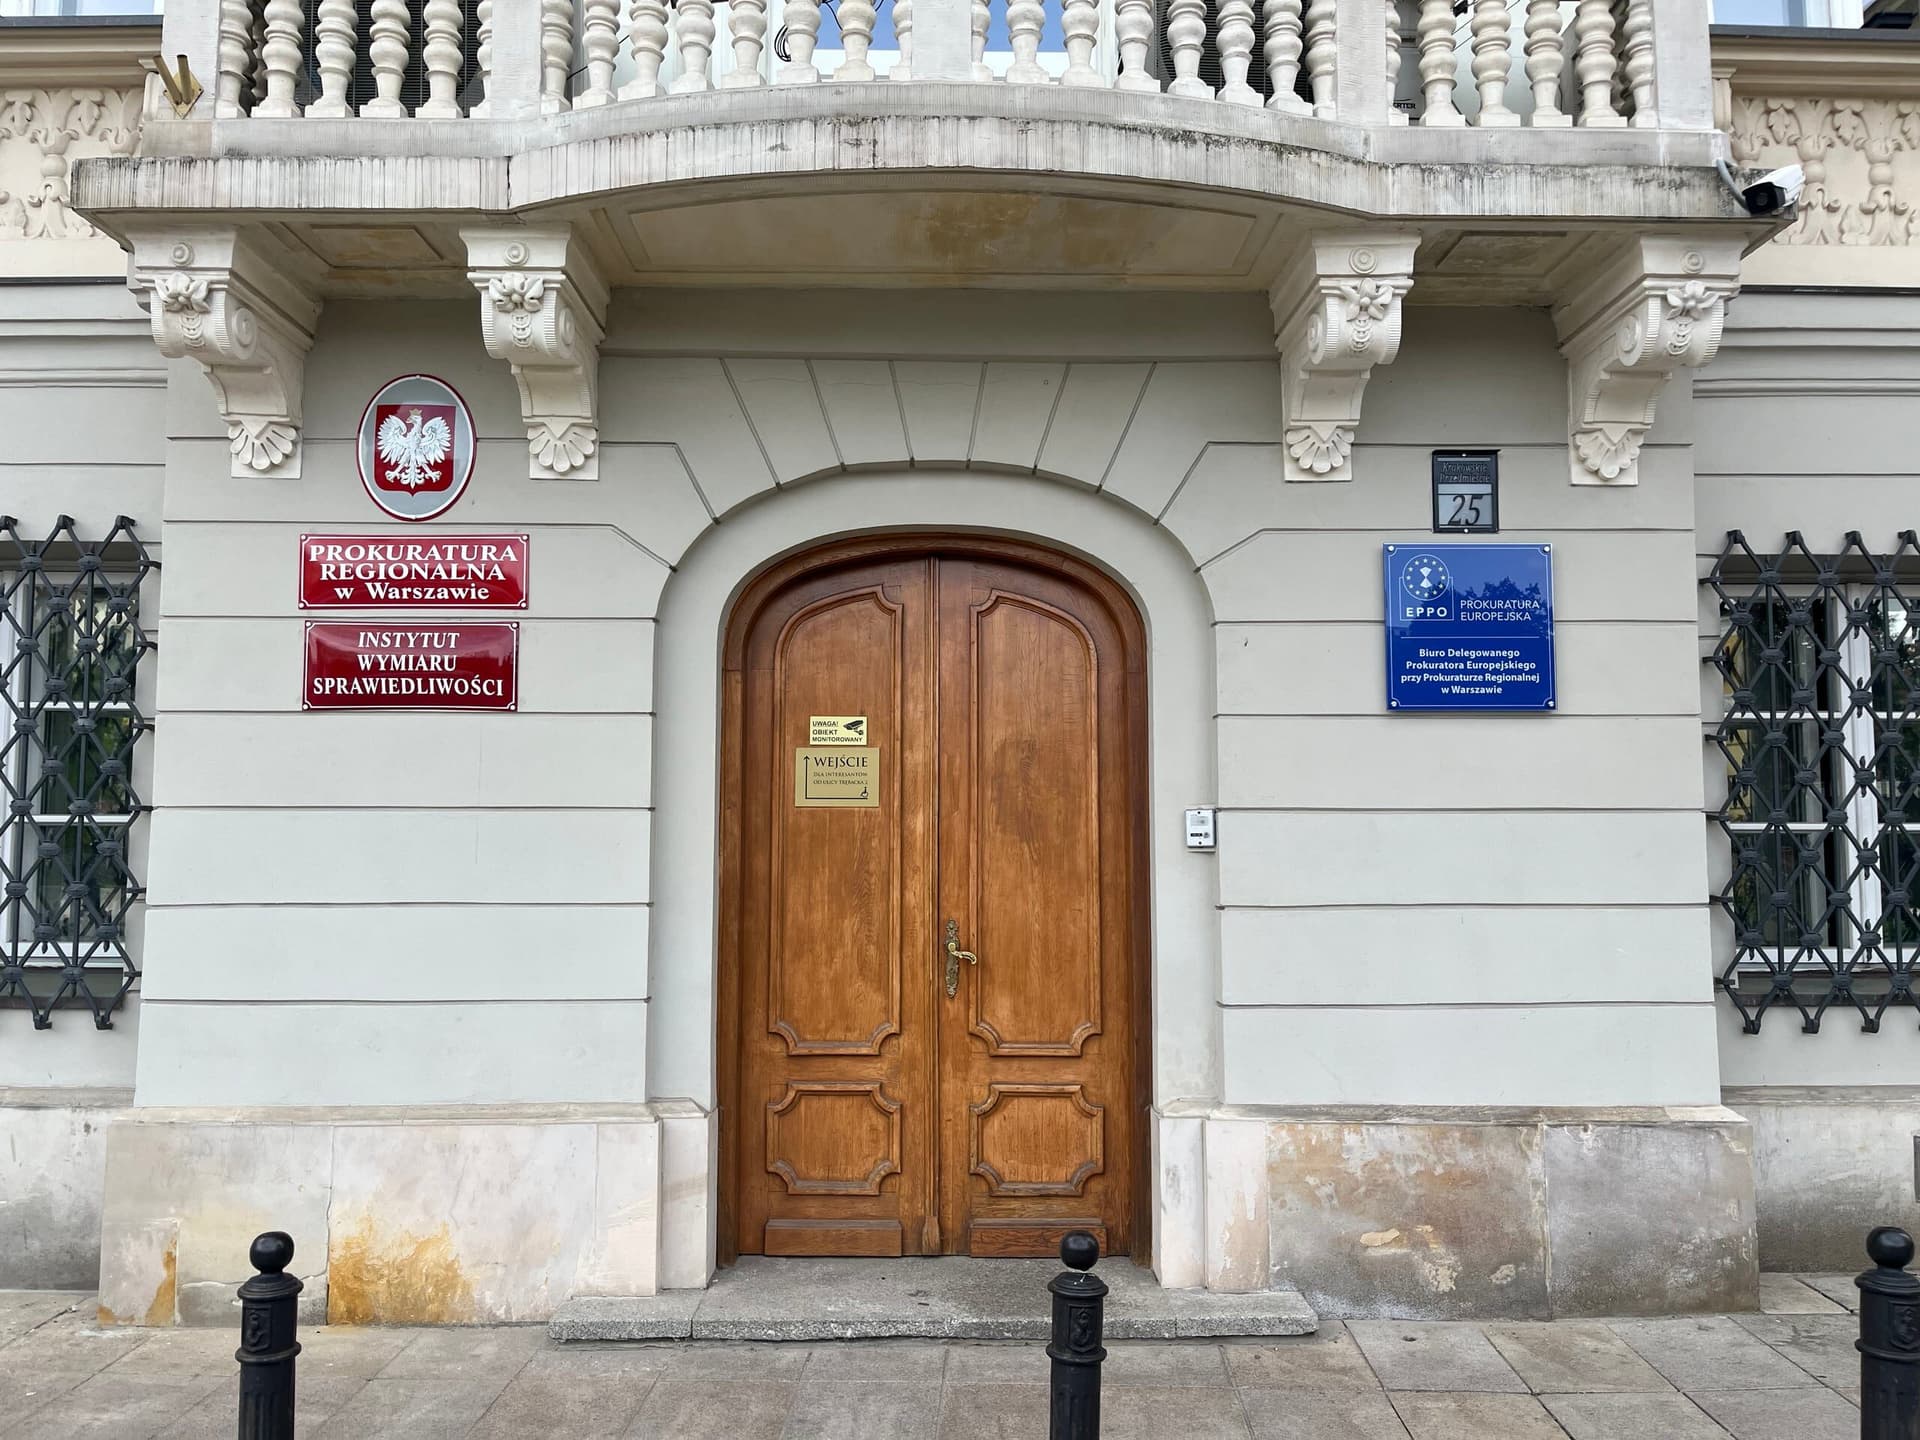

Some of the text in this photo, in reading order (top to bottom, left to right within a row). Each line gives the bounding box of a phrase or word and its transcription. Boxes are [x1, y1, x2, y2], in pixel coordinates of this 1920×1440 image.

[1447, 494, 1484, 526] 25
[309, 544, 519, 562] PROKURATURA
[319, 563, 506, 581] REGIONALNA
[334, 582, 490, 600] w Warszawie
[1406, 607, 1448, 618] EPPO
[1460, 600, 1540, 610] PROKURATURA
[1460, 612, 1532, 622] EUROPEJSKA
[357, 632, 460, 649] INSTYTUT
[1419, 648, 1520, 659] Biuro Delegowanego
[357, 654, 457, 672] WYMIARU
[1406, 661, 1537, 672] Prokuratora Europejskiego
[313, 674, 504, 697] SPRAWIEDLIWOŚCI
[1400, 673, 1541, 684] przy Prokuraturze Regionalnej
[1441, 685, 1503, 695] w Warszawie
[813, 754, 869, 769] WEJŚCIE
